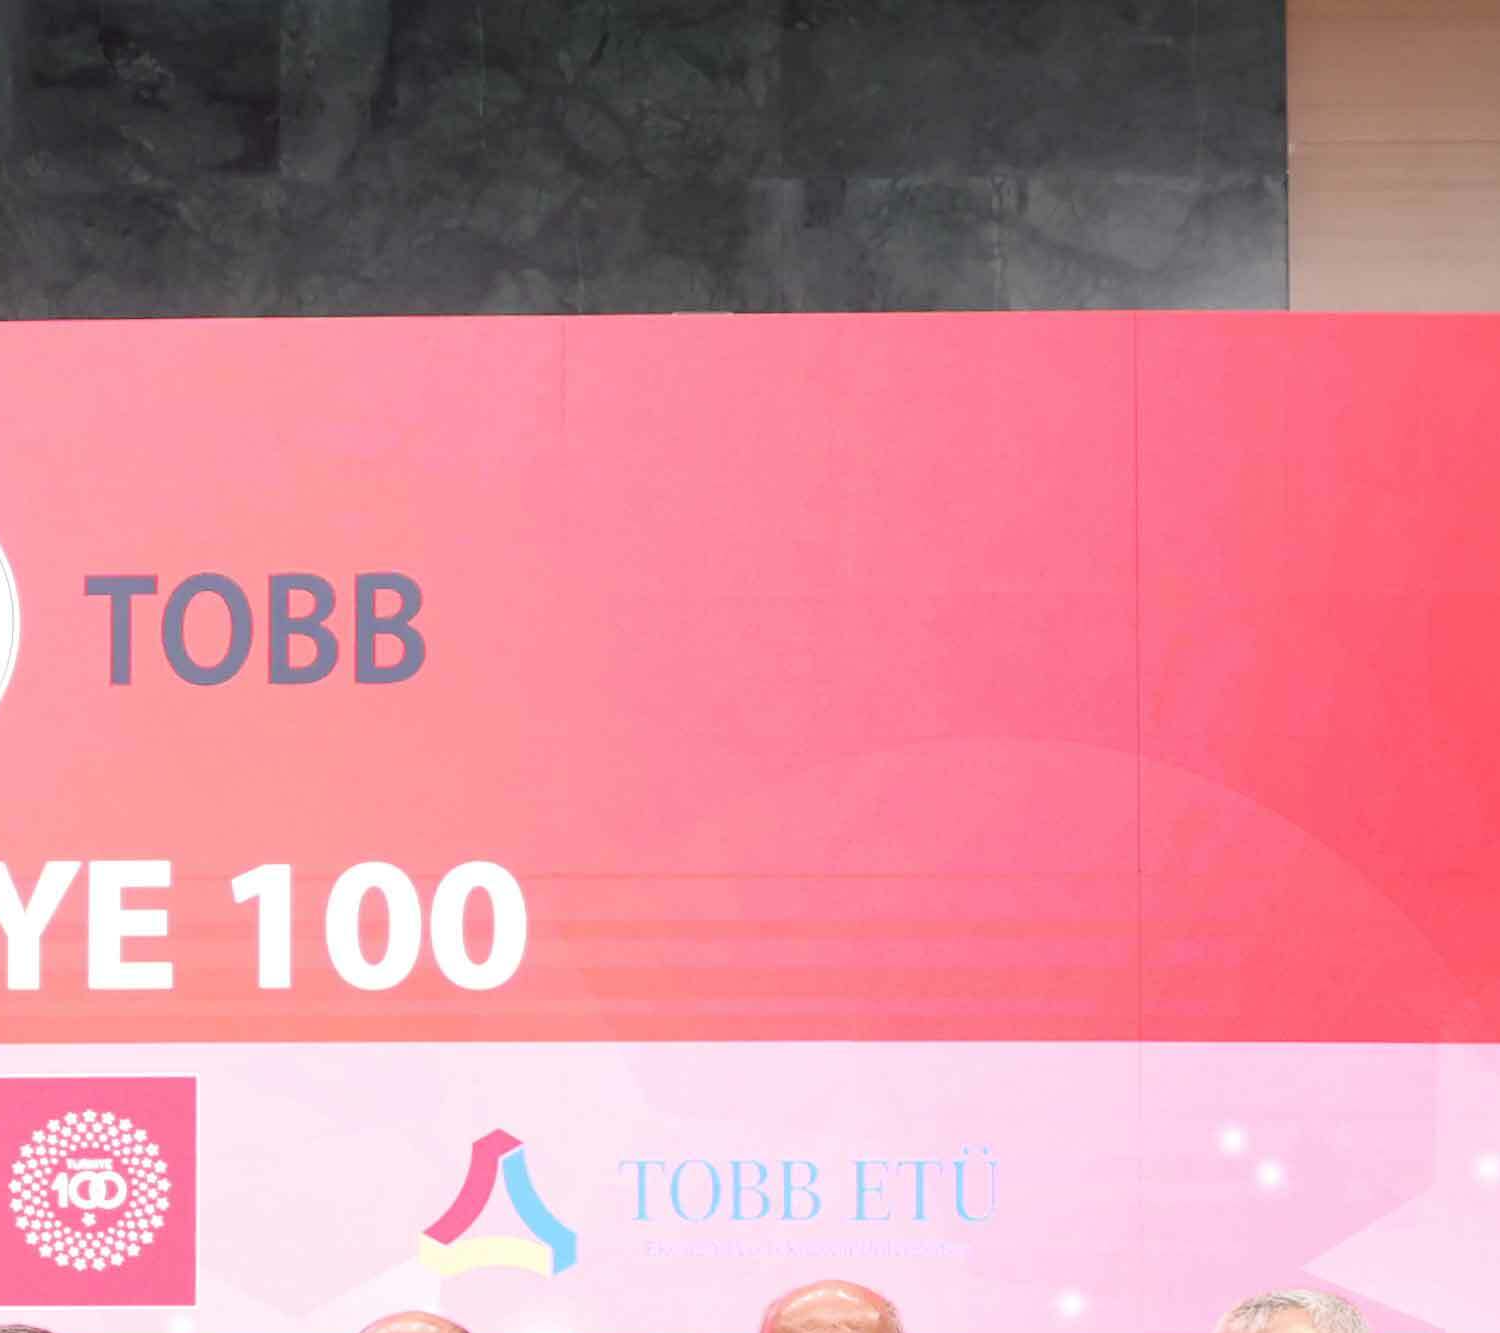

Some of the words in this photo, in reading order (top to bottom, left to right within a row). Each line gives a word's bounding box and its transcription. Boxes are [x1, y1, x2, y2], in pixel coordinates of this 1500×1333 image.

[84, 572, 427, 685] TOBB
[231, 860, 528, 989] 100
[618, 1159, 821, 1222] TOBB
[851, 1145, 1000, 1222] ETÜ
